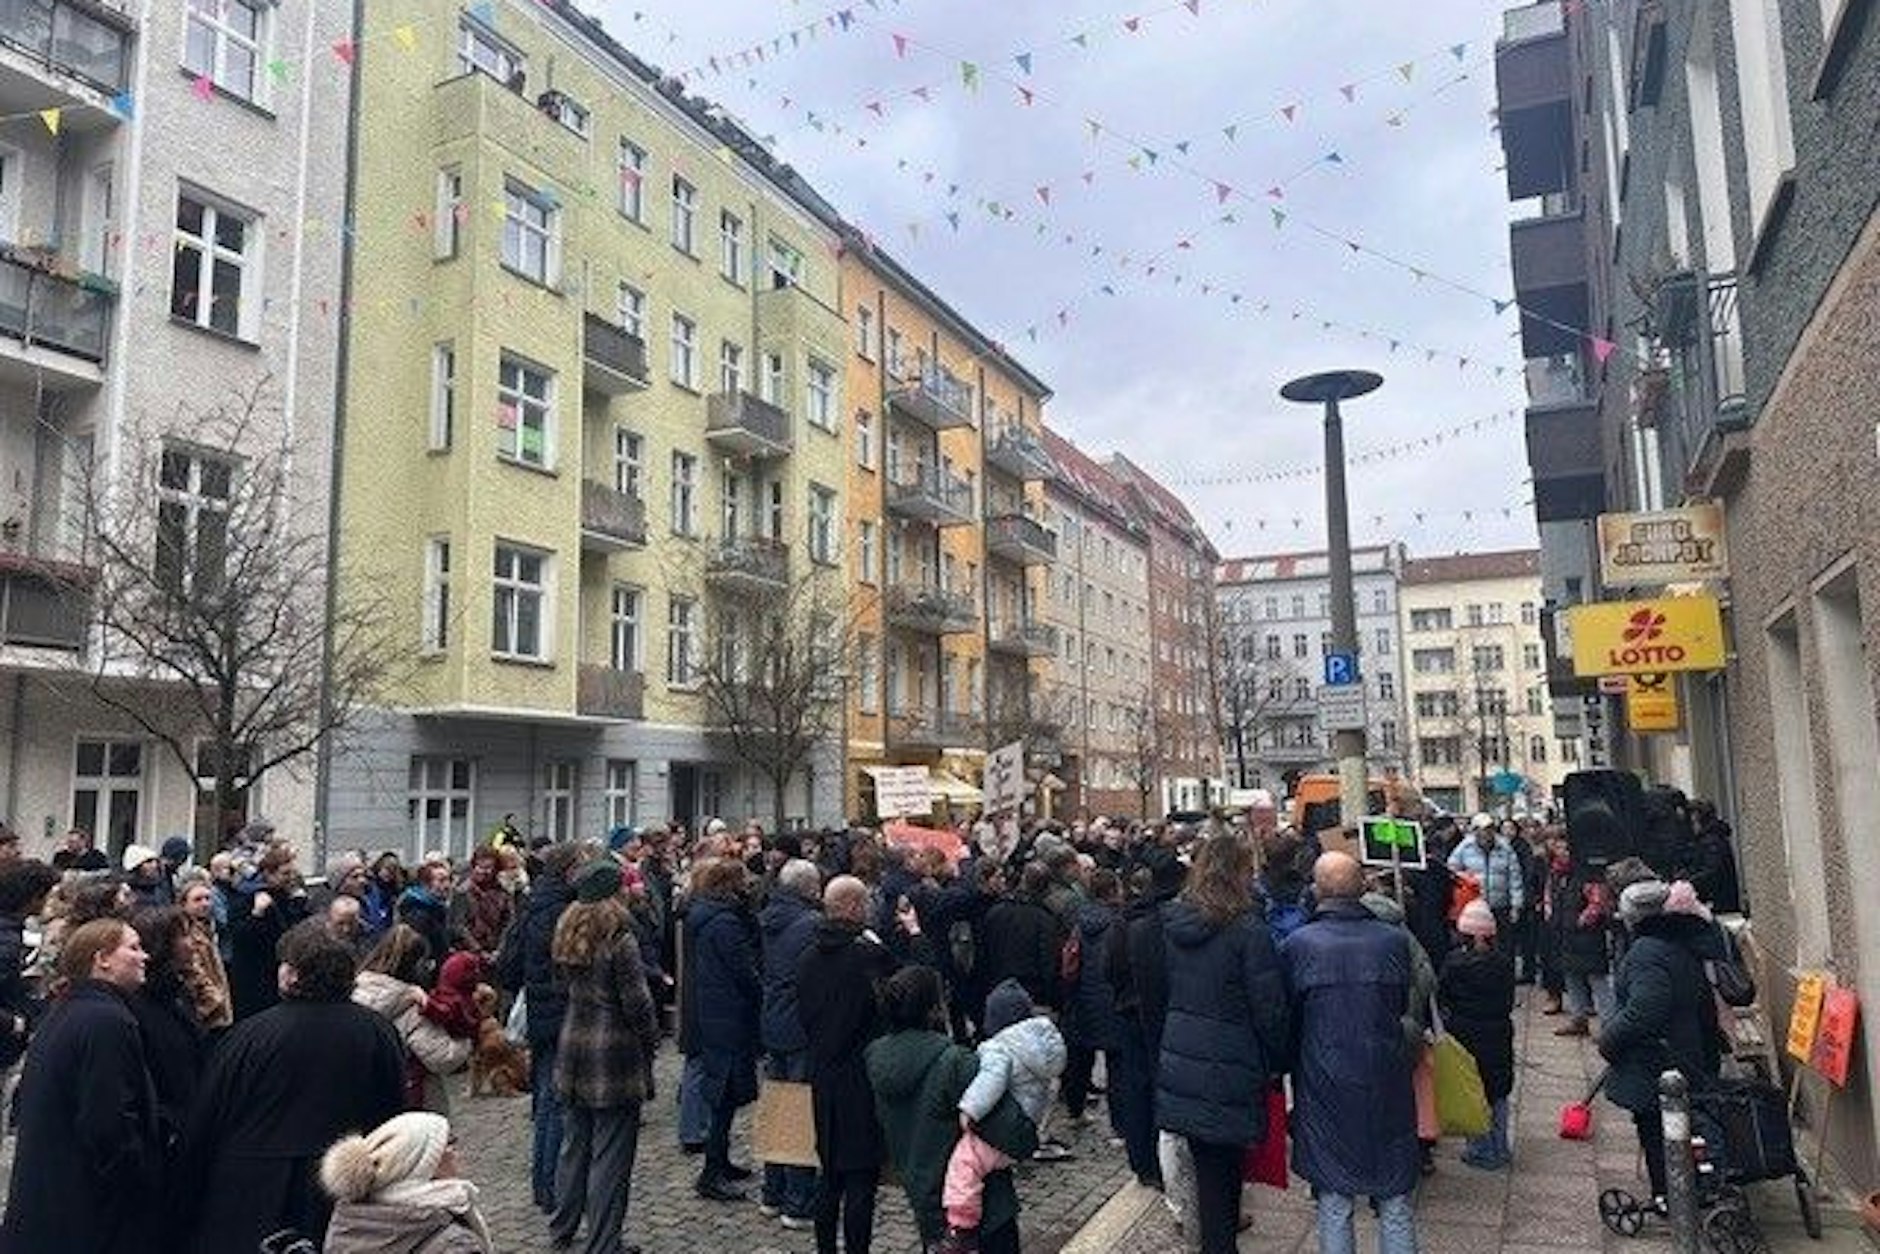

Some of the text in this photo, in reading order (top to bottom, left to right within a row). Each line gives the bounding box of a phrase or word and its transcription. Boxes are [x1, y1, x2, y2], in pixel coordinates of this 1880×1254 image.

[1631, 519, 1691, 543] EURO
[1613, 538, 1714, 566] JACKPOT
[1610, 645, 1685, 667] LOTTO
[1328, 656, 1346, 682] P
